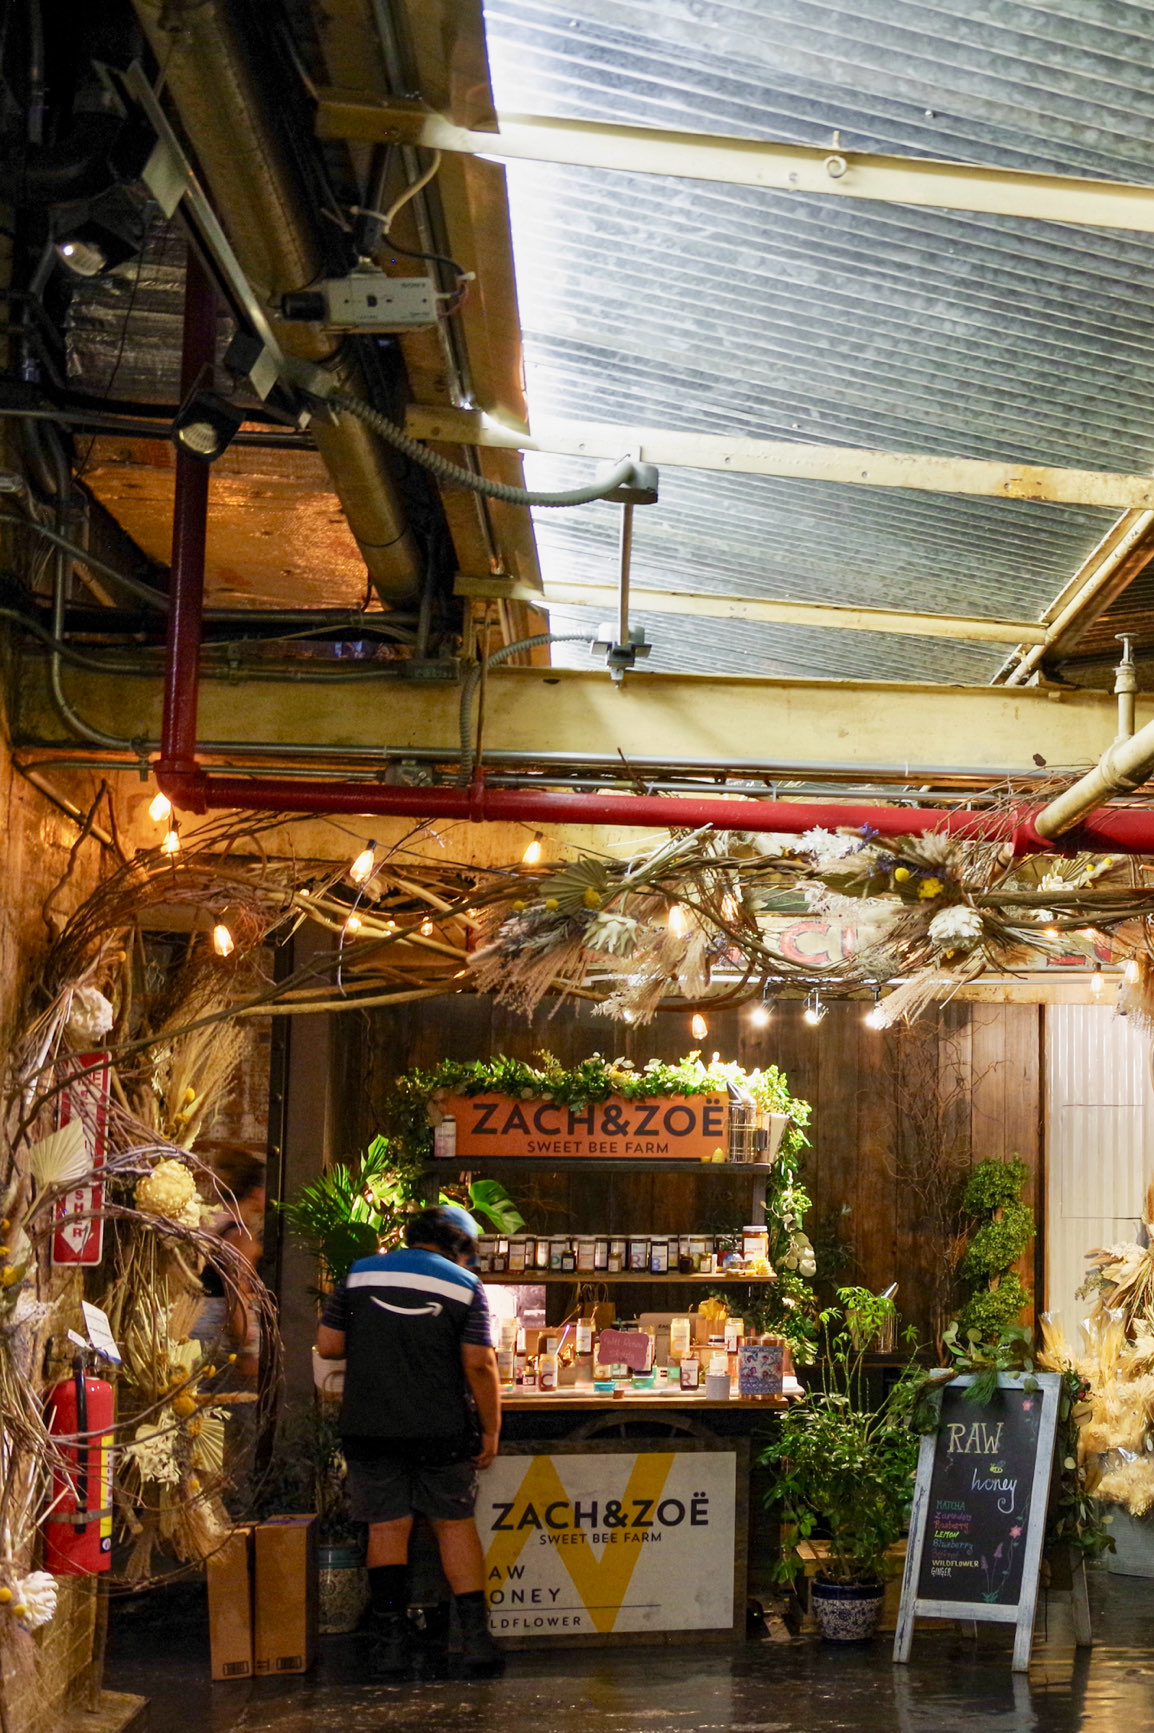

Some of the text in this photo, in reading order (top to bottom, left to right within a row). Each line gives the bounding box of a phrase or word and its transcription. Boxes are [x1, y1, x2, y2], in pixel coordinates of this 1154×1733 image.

[471, 1098, 724, 1137] ZACH&ZOË
[526, 1141, 669, 1153] SWEET BEE FARM
[947, 1423, 1004, 1453] RAW
[970, 1467, 1018, 1514] honey
[491, 1491, 709, 1531] ZACH&ZOË
[936, 1500, 966, 1511] MATCHA
[539, 1532, 662, 1545] SWEET BEE FARM
[934, 1530, 960, 1538] LEMON
[932, 1559, 979, 1567] WILDFLOWER
[488, 1565, 525, 1580] AW
[489, 1588, 561, 1605] ONEY
[490, 1616, 581, 1629] LDFLOWER
